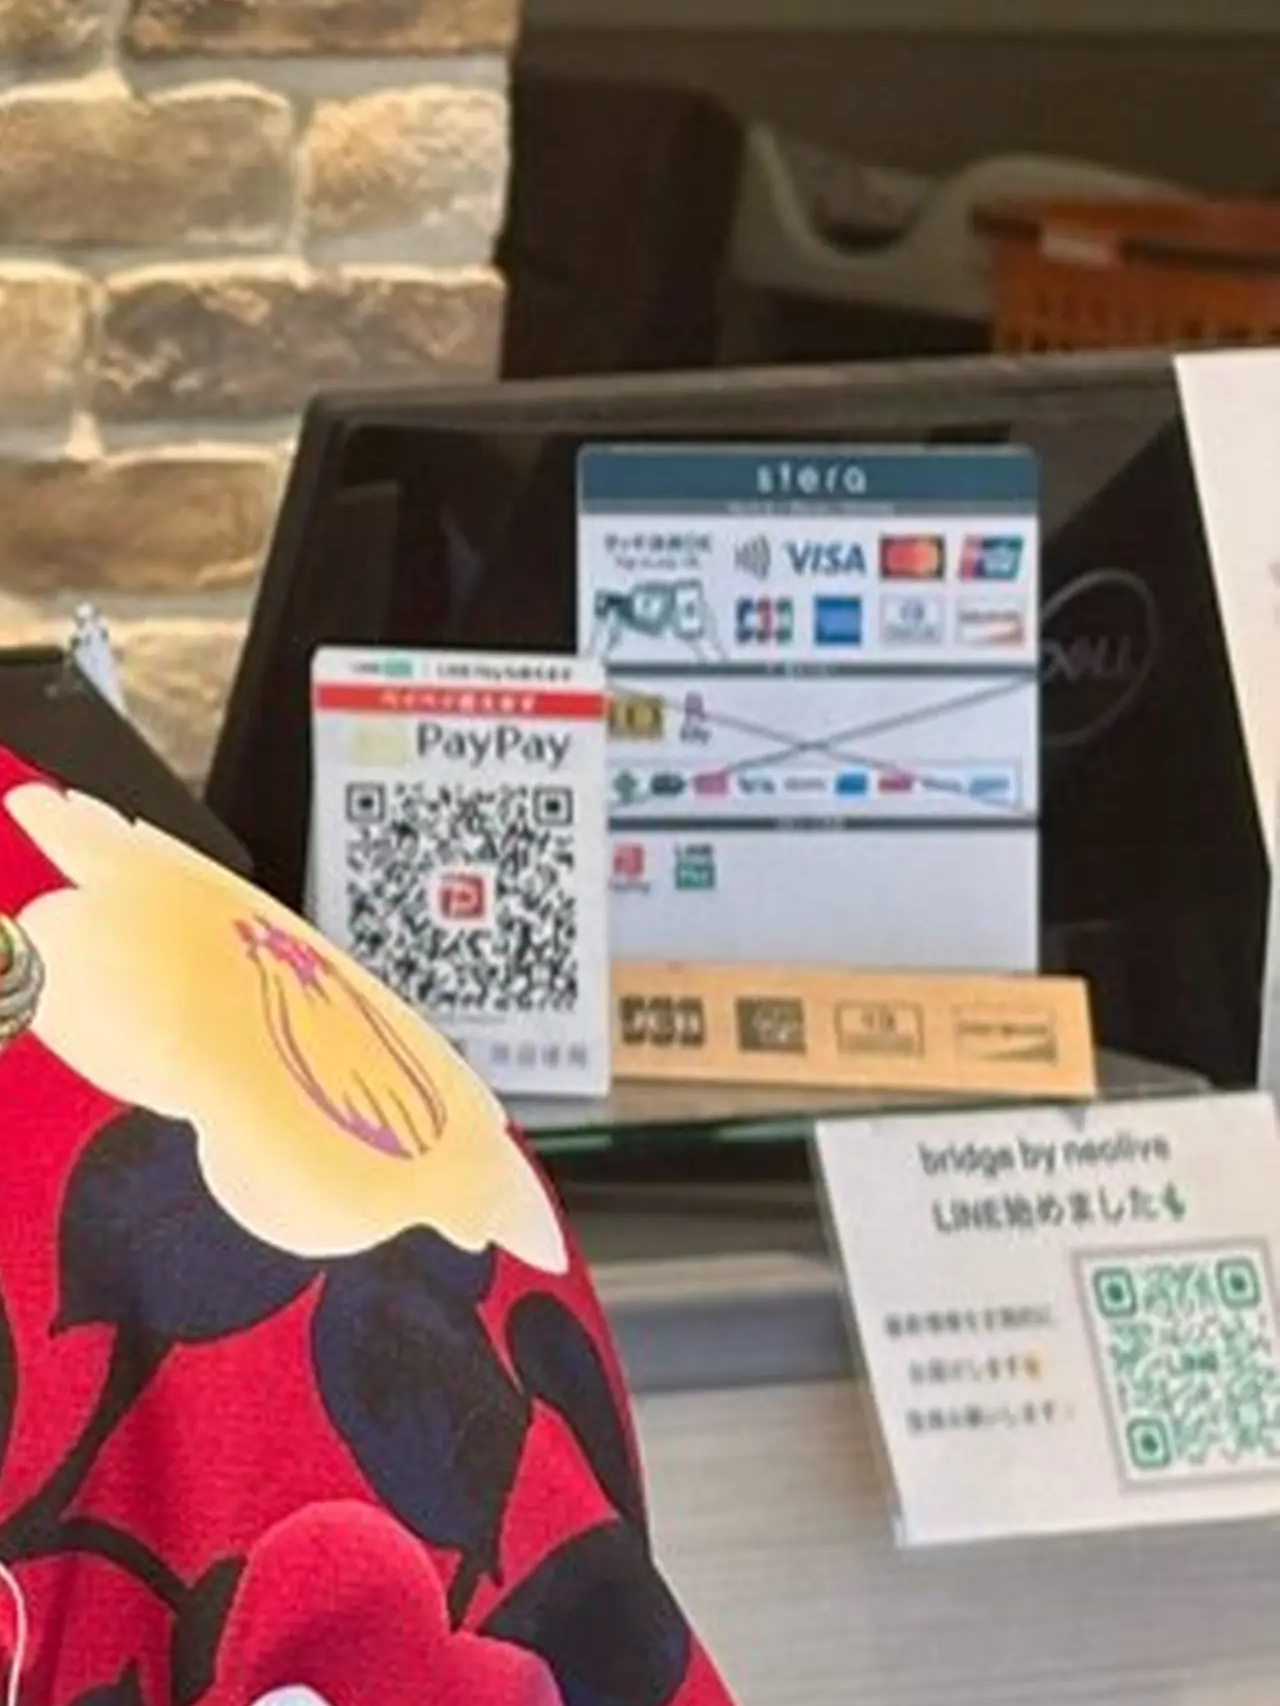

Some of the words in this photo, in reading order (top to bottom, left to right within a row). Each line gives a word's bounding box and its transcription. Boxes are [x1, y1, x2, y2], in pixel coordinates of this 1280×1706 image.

[756, 465, 868, 494] stera
[787, 541, 867, 576] VISA
[416, 723, 572, 769] PayPay
[918, 1139, 1016, 1178] bridge
[1017, 1136, 1056, 1174] by
[1062, 1130, 1170, 1166] neolive
